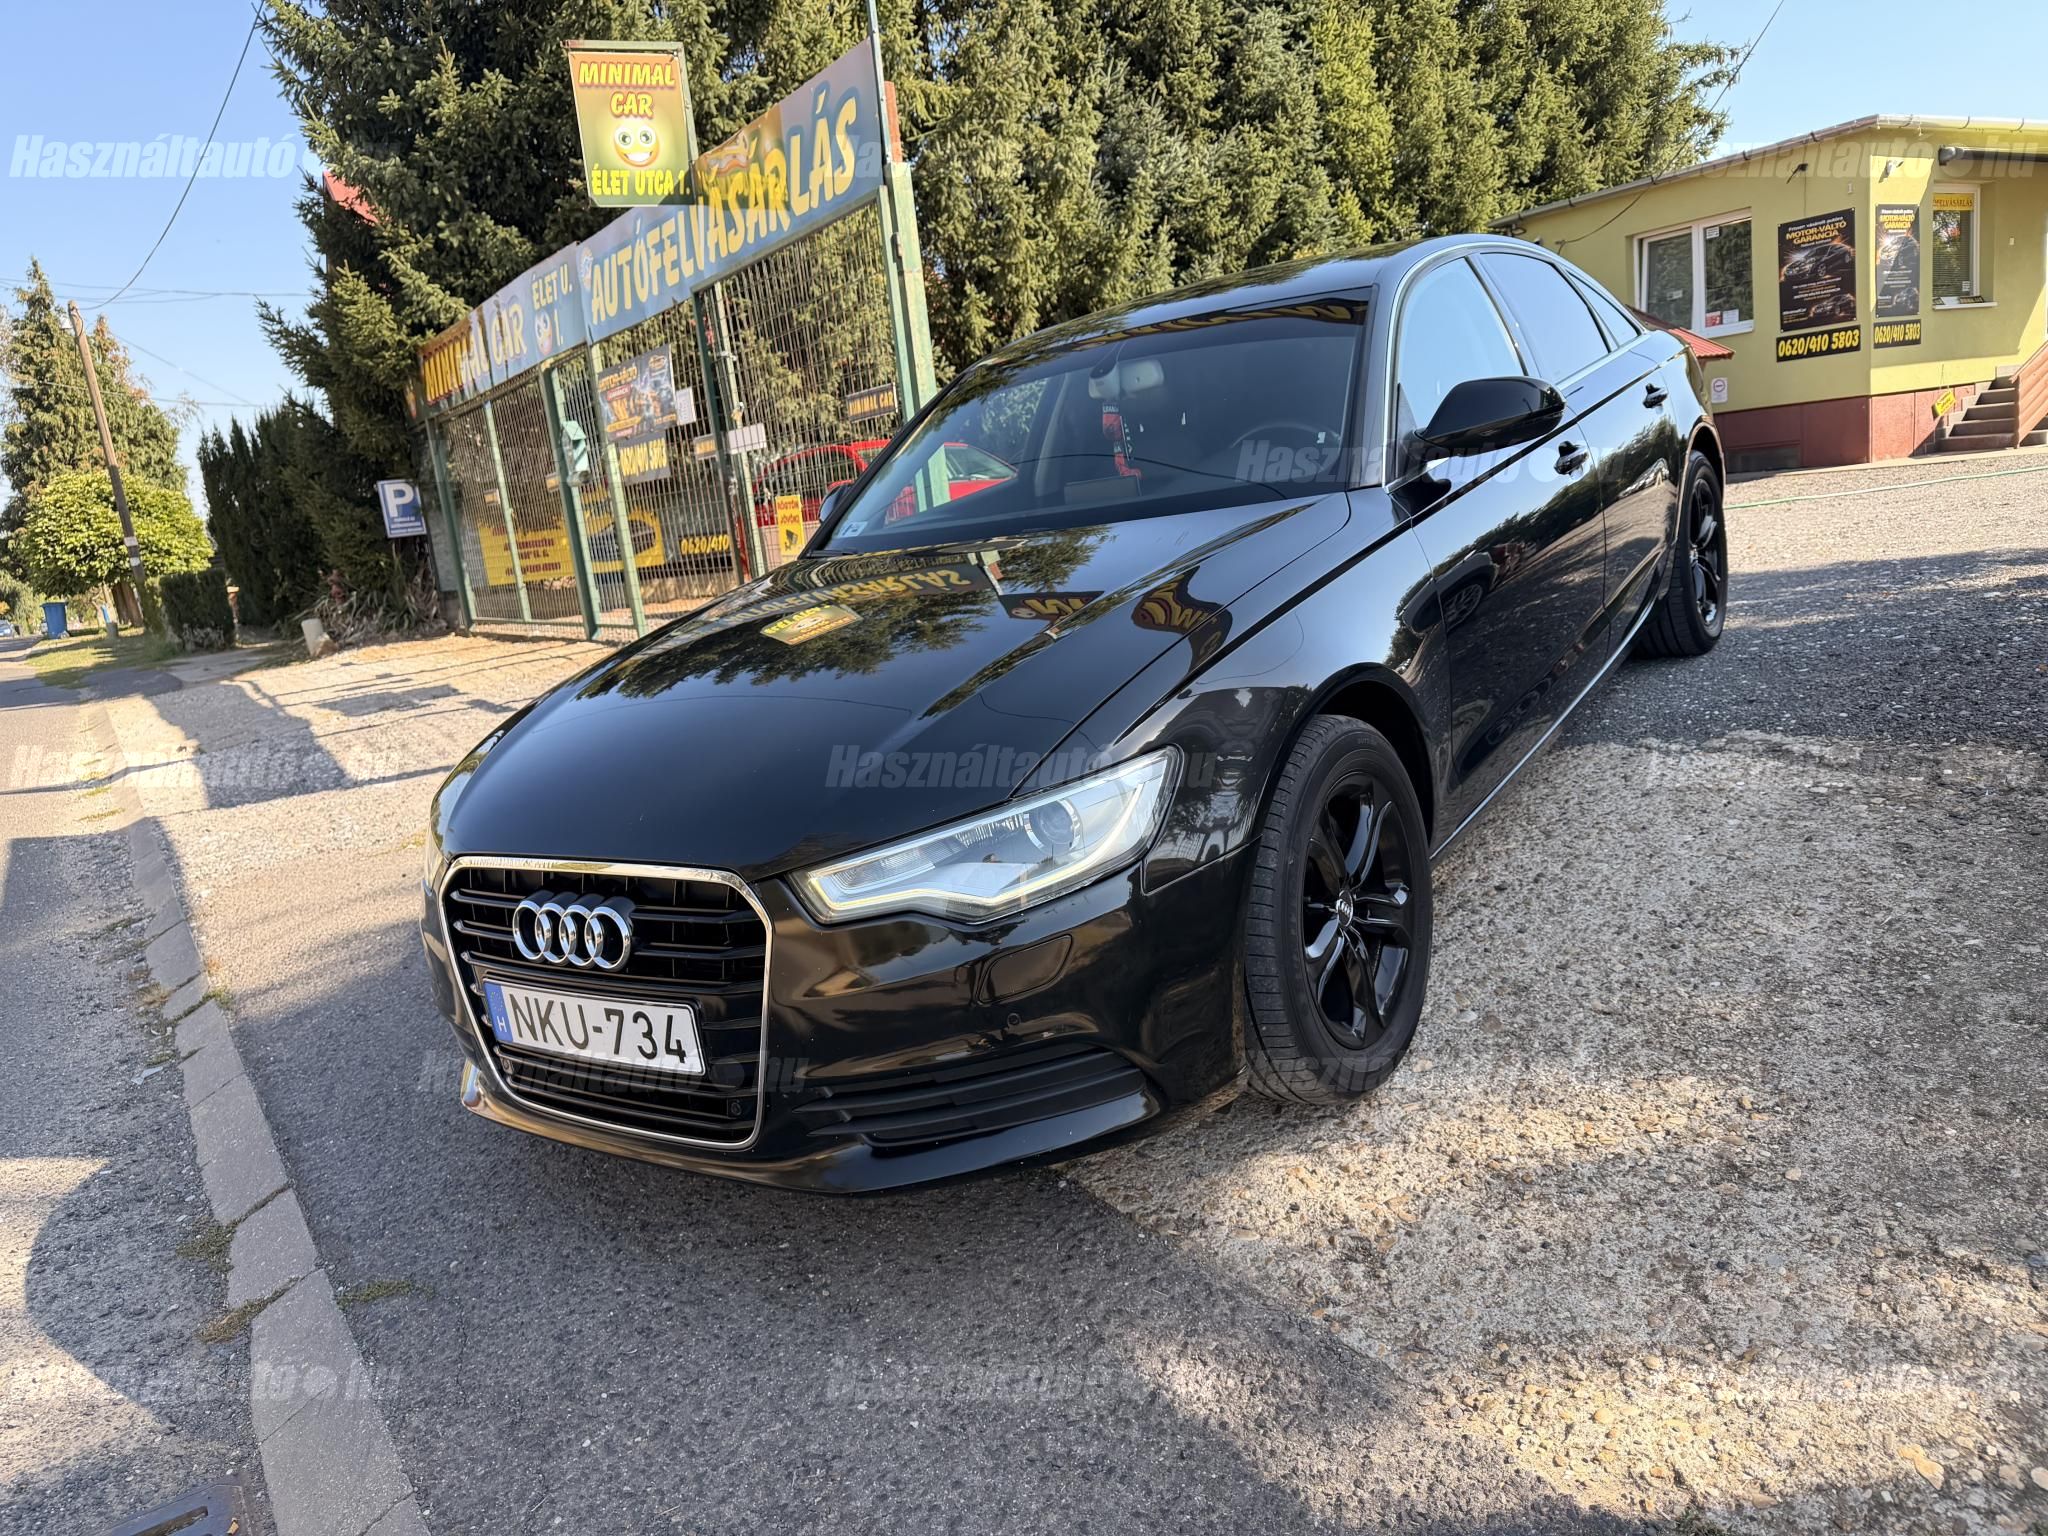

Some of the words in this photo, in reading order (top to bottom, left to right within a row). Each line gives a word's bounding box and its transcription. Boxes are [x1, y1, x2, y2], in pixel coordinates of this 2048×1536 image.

[578, 62, 675, 87] MINIMAL
[611, 92, 653, 117] CAR
[592, 163, 630, 195] ÉLET
[635, 170, 674, 195] UTCA
[678, 171, 690, 195] 1.
[592, 90, 857, 325] AUTÓFELVÁSÁRLÁS
[1786, 219, 1847, 240] MOTOR-VÁLTÓ
[1793, 229, 1839, 245] GARANCIA
[532, 270, 558, 311] ÉLET
[560, 263, 573, 296] U.
[491, 303, 527, 366] CAR
[1778, 334, 1829, 358] 0620/410
[1831, 328, 1860, 350] 5803
[1875, 324, 1904, 345] 0620/410
[1905, 322, 1920, 341] 5803
[384, 483, 414, 517] P
[498, 1016, 507, 1033] H
[508, 994, 687, 1064] NKU-734
